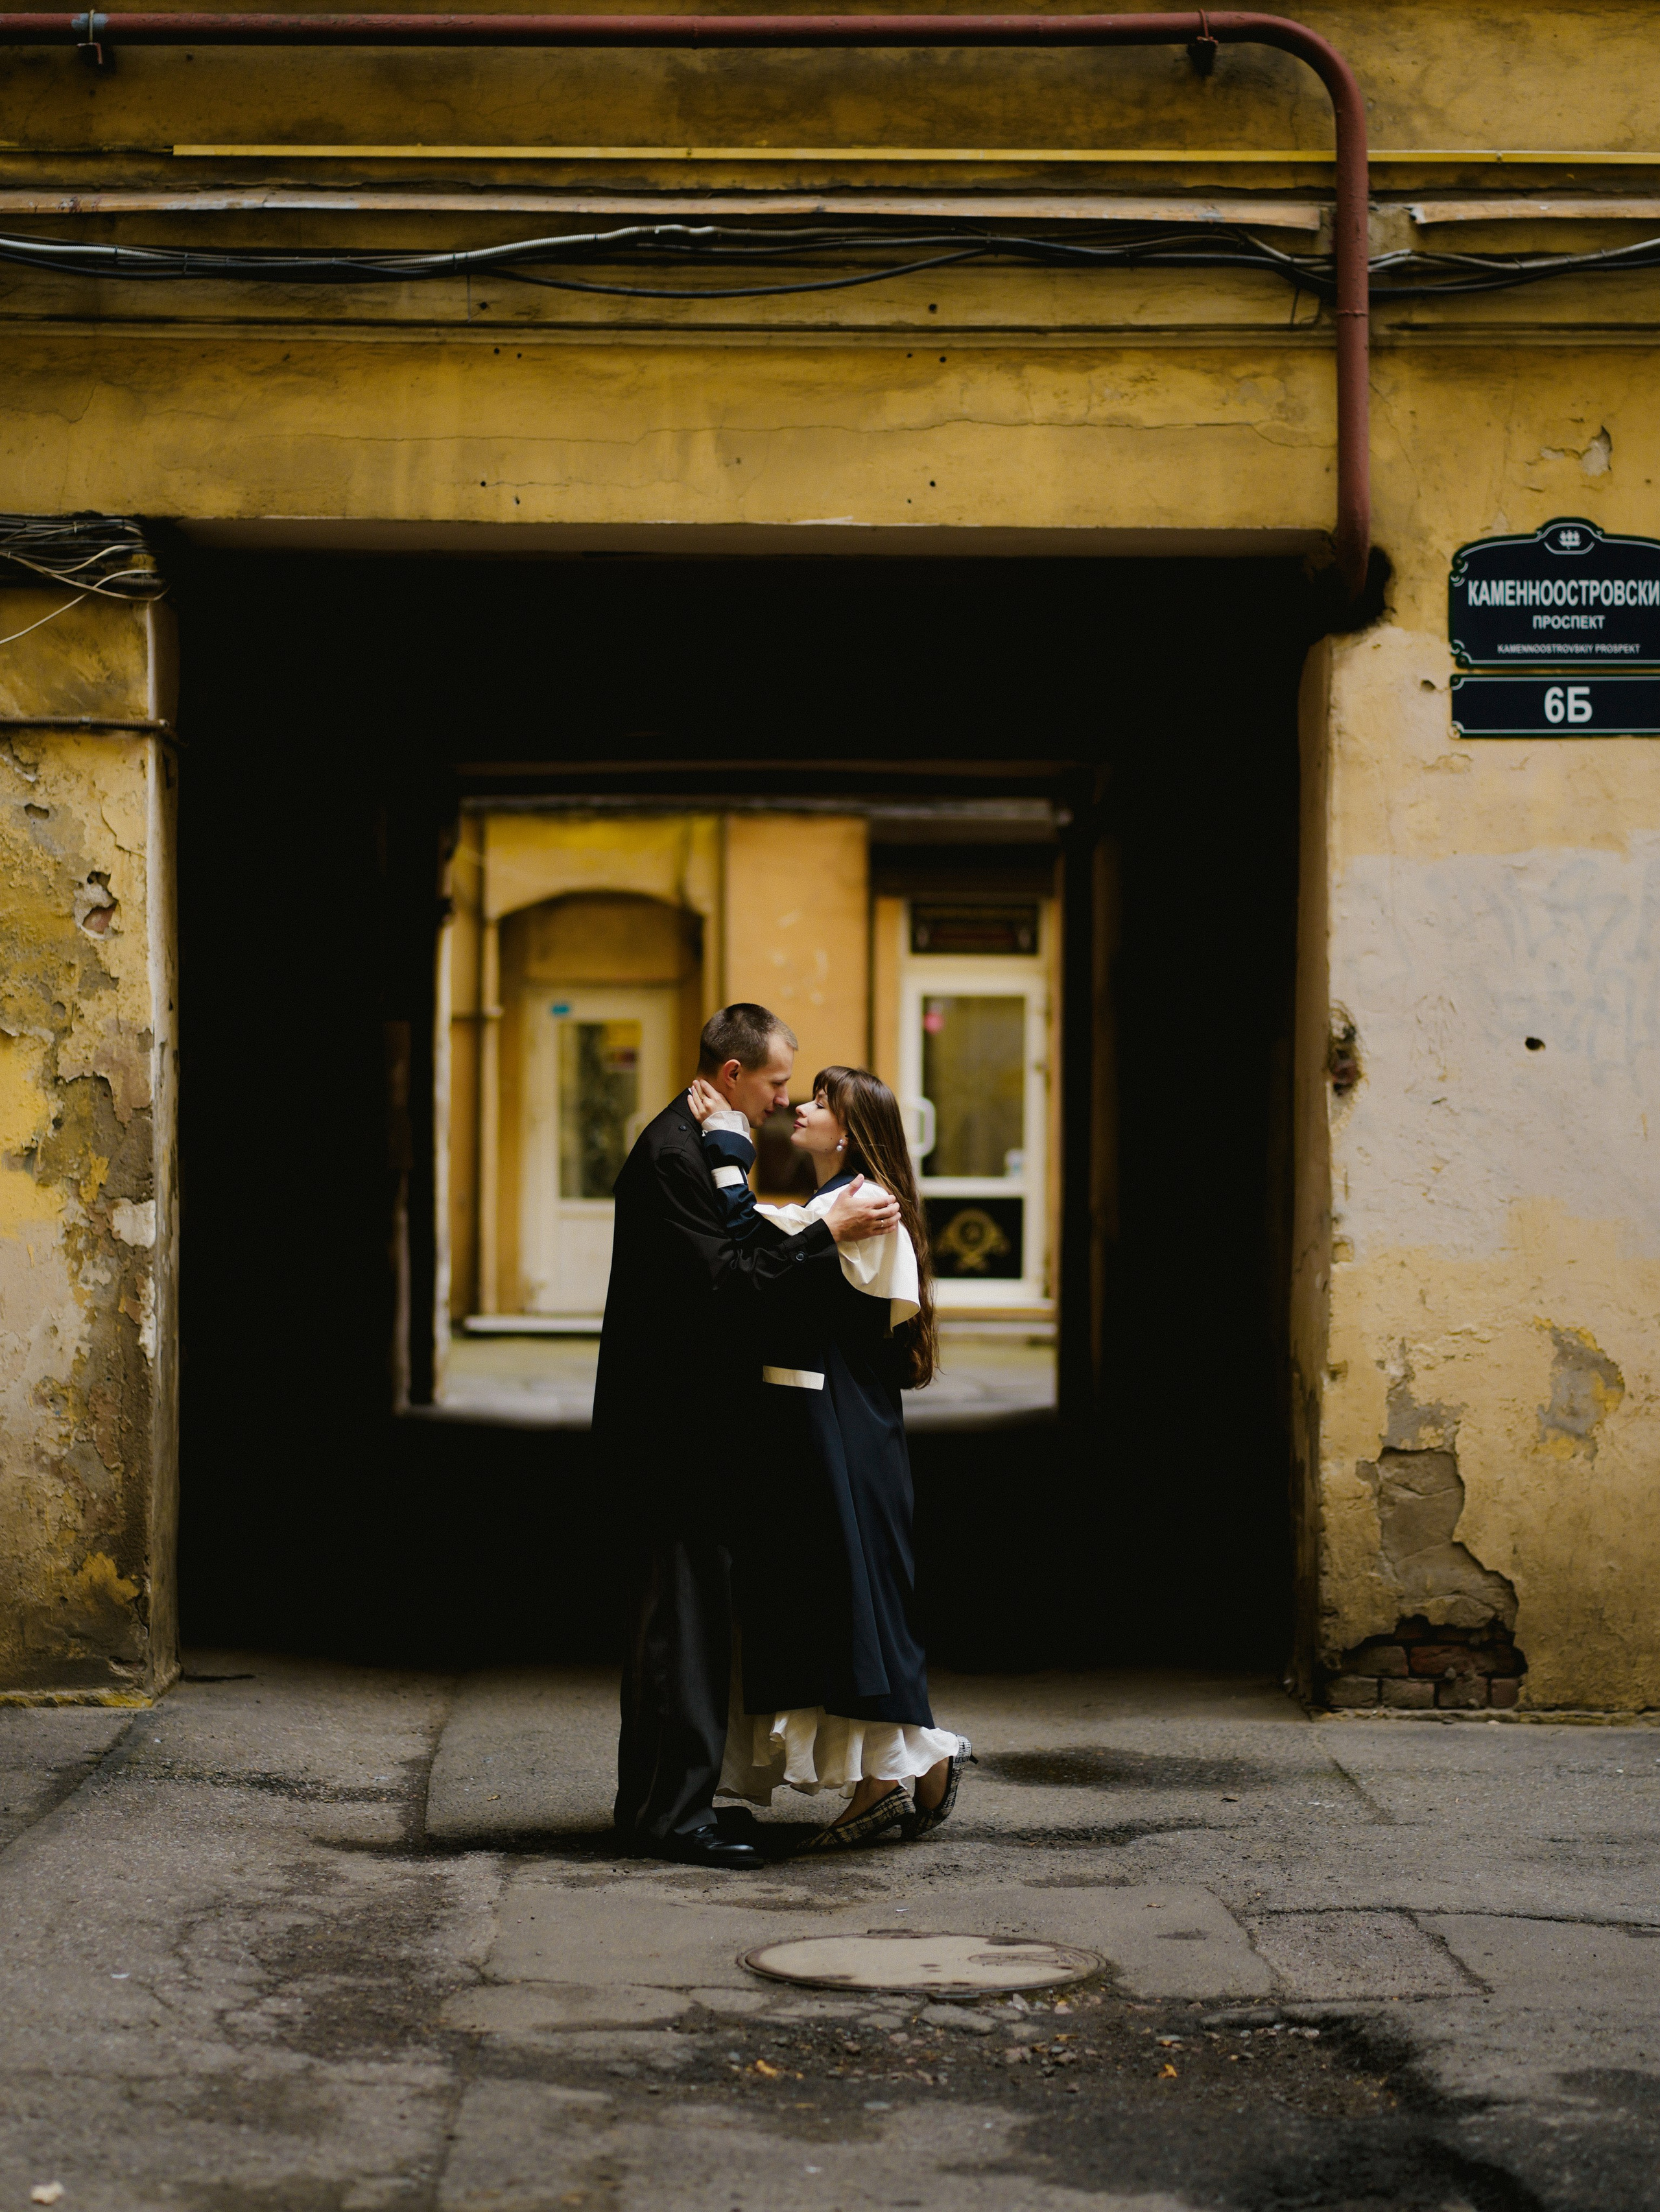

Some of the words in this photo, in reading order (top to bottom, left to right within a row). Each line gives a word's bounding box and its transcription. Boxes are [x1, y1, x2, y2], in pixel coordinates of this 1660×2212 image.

[1467, 580, 1660, 606] КАМЕННООСТРОВСКИ
[1532, 615, 1606, 630] ПРОСПЕКТ
[1497, 644, 1593, 654] KAMENNOOSTROVSKIY
[1595, 644, 1641, 654] PROSPEKT
[1544, 686, 1593, 724] 6Б
